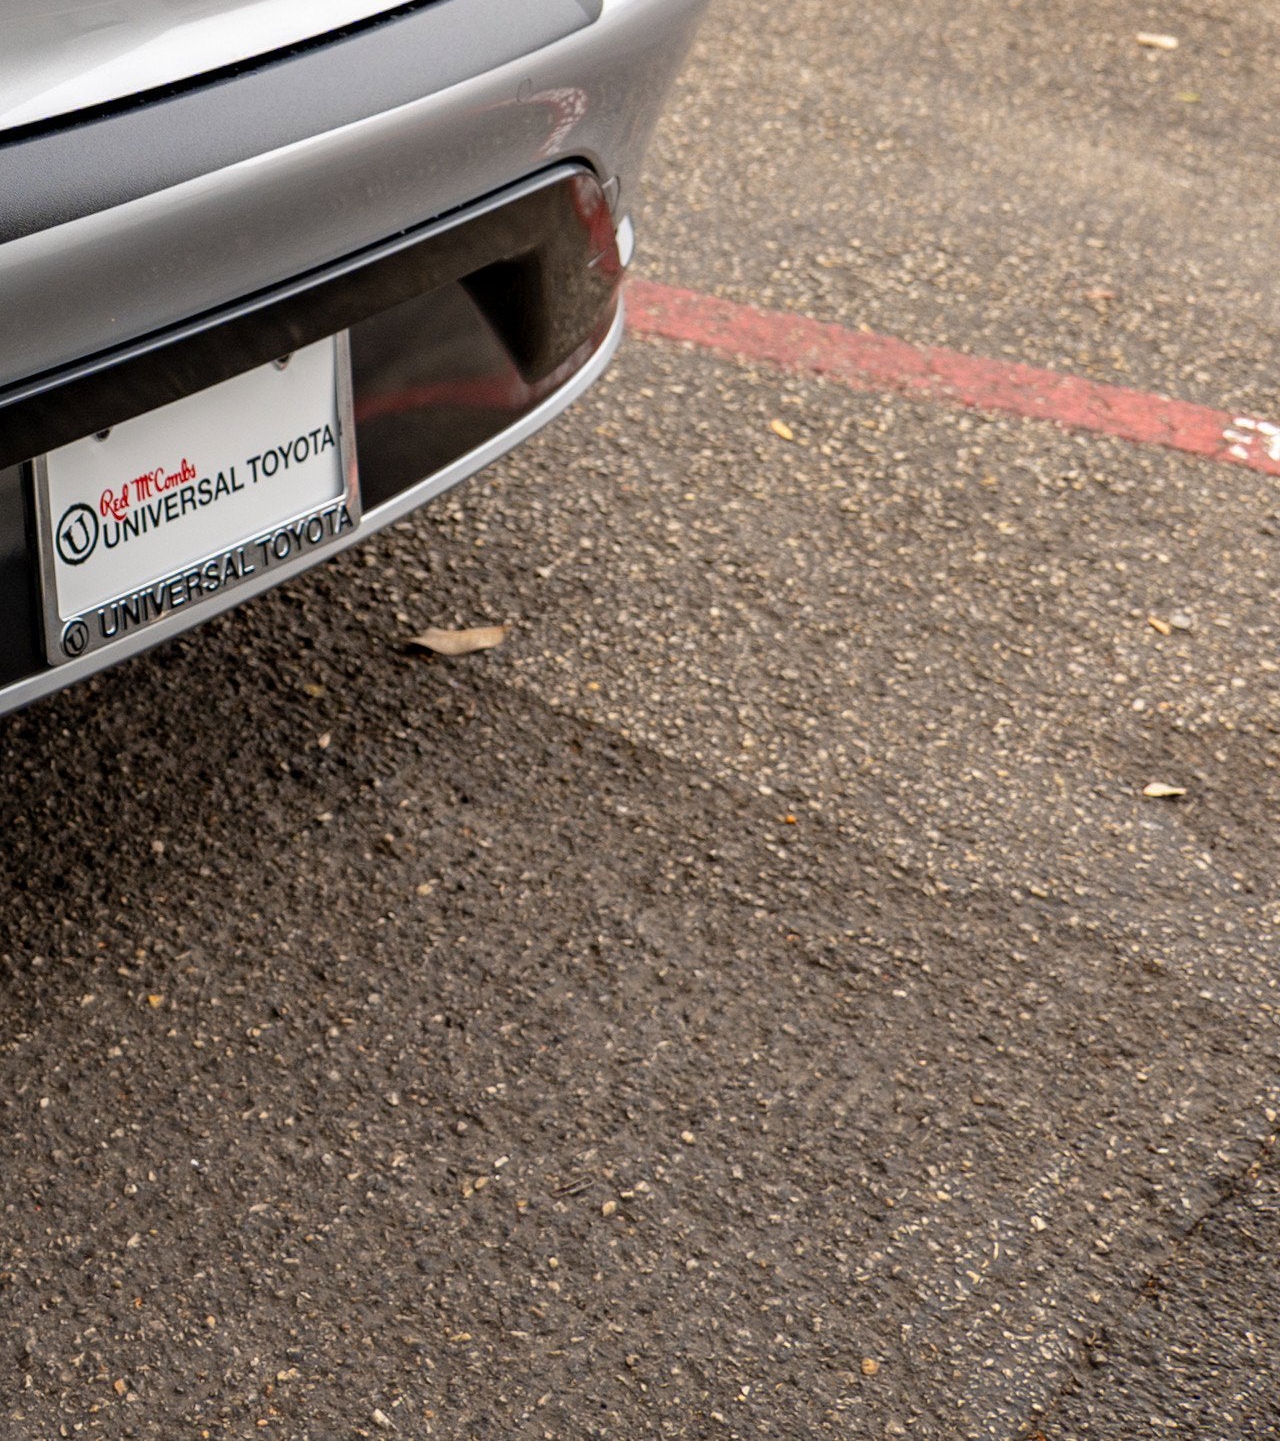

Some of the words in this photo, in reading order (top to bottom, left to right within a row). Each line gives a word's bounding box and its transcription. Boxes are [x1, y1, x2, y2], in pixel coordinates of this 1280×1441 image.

[100, 485, 130, 520] Red
[103, 466, 244, 548] UNIVERSAL
[247, 424, 335, 483] TOYOTA
[98, 547, 255, 638] UNIVERSAL
[254, 500, 353, 566] TOYOTA
